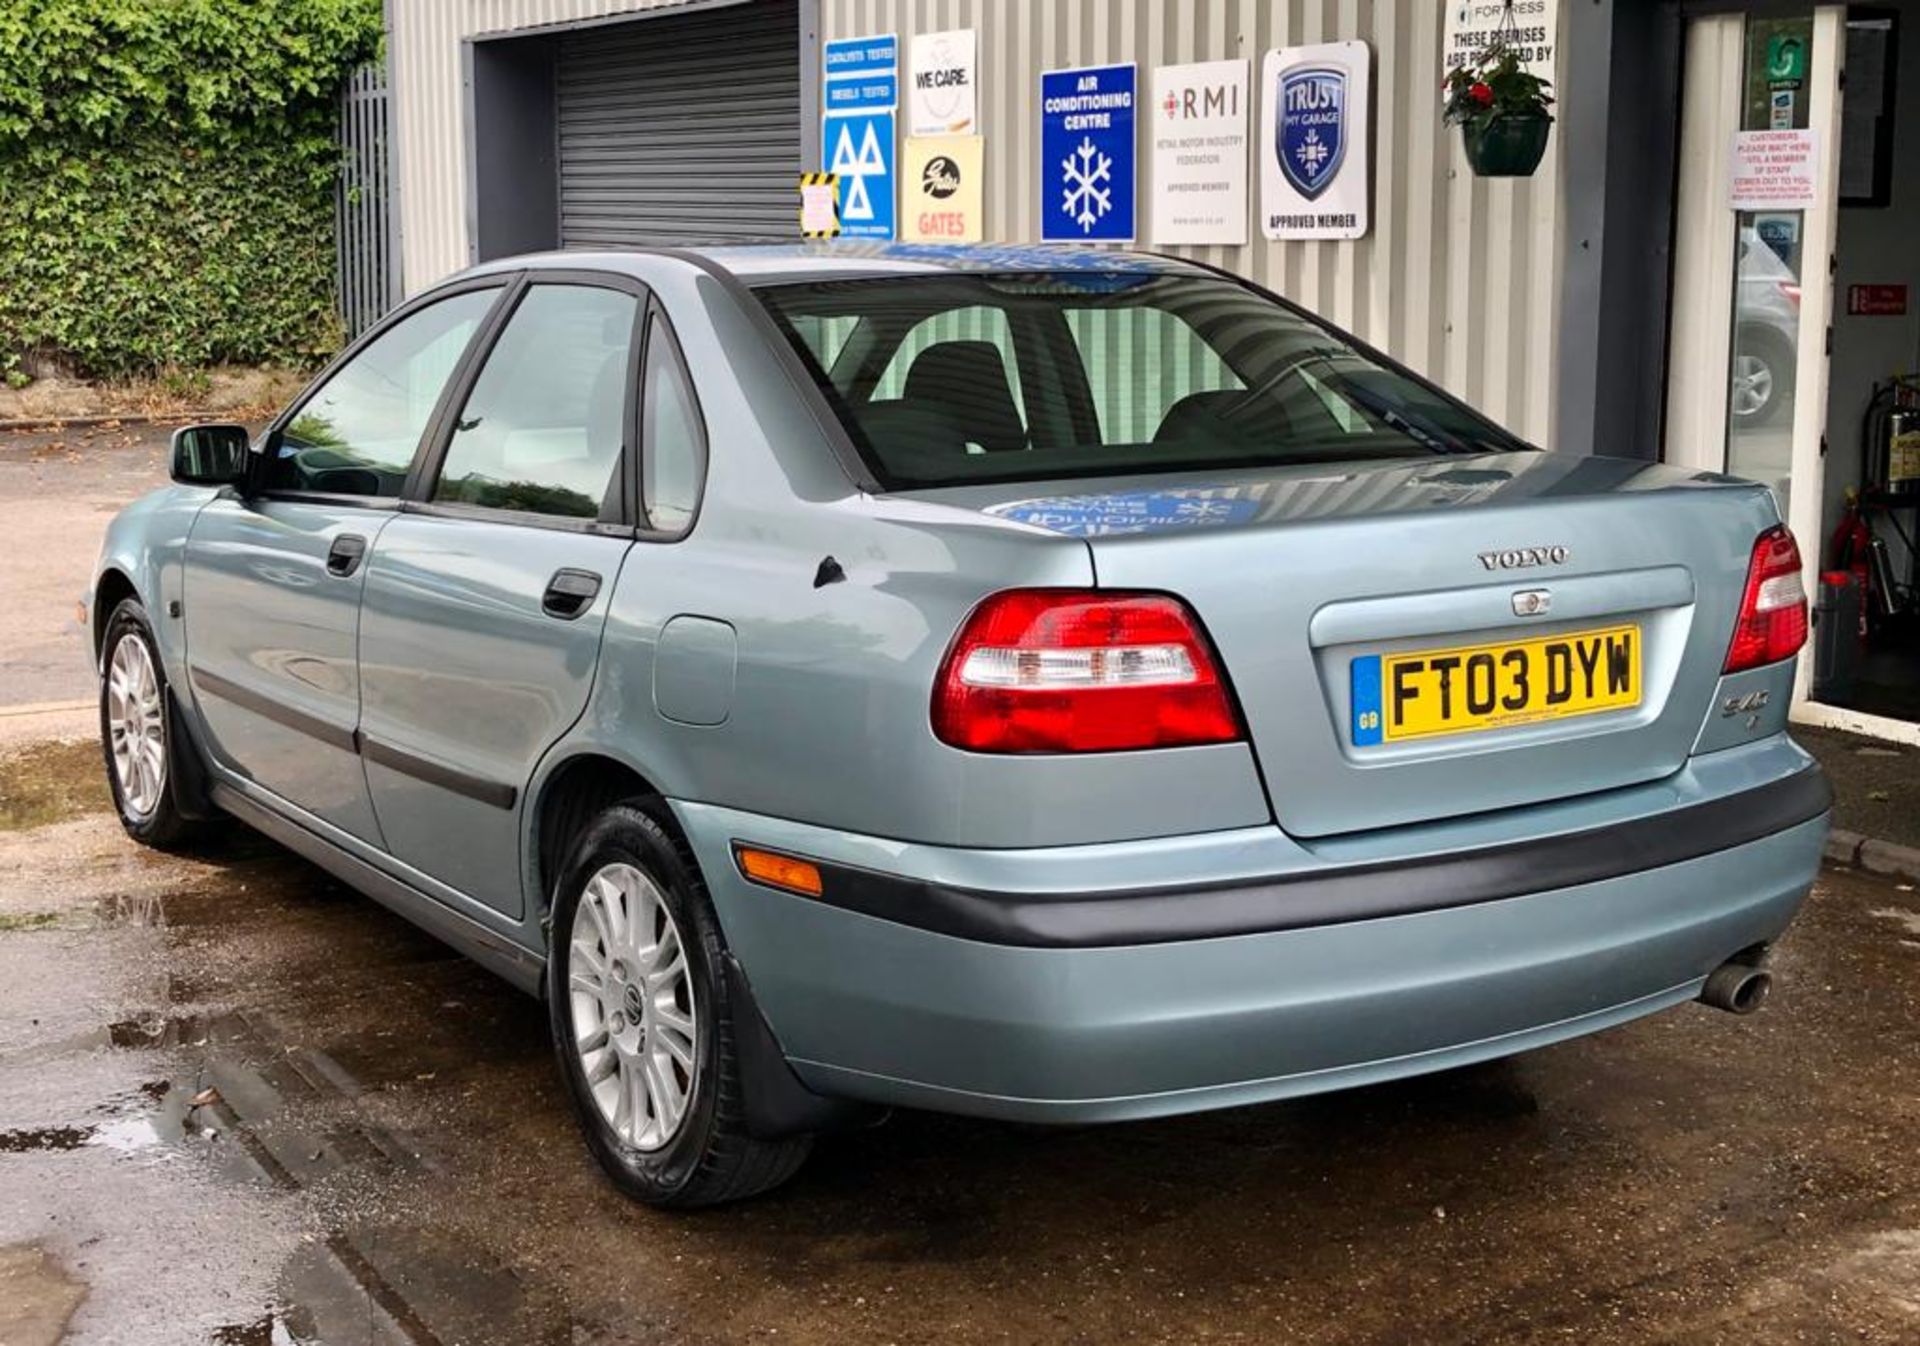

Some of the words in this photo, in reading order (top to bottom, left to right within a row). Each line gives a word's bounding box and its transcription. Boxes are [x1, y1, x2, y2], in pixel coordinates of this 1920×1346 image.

[1475, 1, 1544, 17] FORRESS
[1454, 31, 1487, 48] THESE
[1490, 27, 1545, 44] PREMISES
[1447, 52, 1466, 66] ARE
[1536, 46, 1552, 62] BY
[916, 71, 933, 90] WE
[935, 68, 969, 87] CARE.
[1077, 76, 1098, 92] AIR
[1045, 92, 1131, 113] CONDITIONING
[1183, 84, 1237, 119] RMI
[1286, 79, 1341, 111] TRUST
[1064, 113, 1111, 130] CENTRE
[1286, 115, 1300, 127] MY
[1301, 111, 1339, 125] GARAGE
[1179, 137, 1205, 149] MOTOR
[1206, 135, 1243, 147] INDUSTRY
[1737, 143, 1766, 152] PLEASE
[1768, 143, 1787, 152] WAIT
[1789, 142, 1810, 151] HERE
[1176, 154, 1220, 166] FEDERATION
[1771, 154, 1806, 162] MEMBER
[1766, 166, 1791, 174] STAFF
[1167, 183, 1200, 193] APPROVED
[1201, 182, 1230, 192] MEMBER
[919, 212, 965, 236] GATES
[1270, 215, 1315, 229] APPROVED
[1317, 213, 1356, 228] MEMBER
[1477, 546, 1570, 570] VOLVO
[1393, 649, 1530, 726] FT03
[1545, 633, 1631, 705] DYW
[1359, 711, 1378, 730] GB
